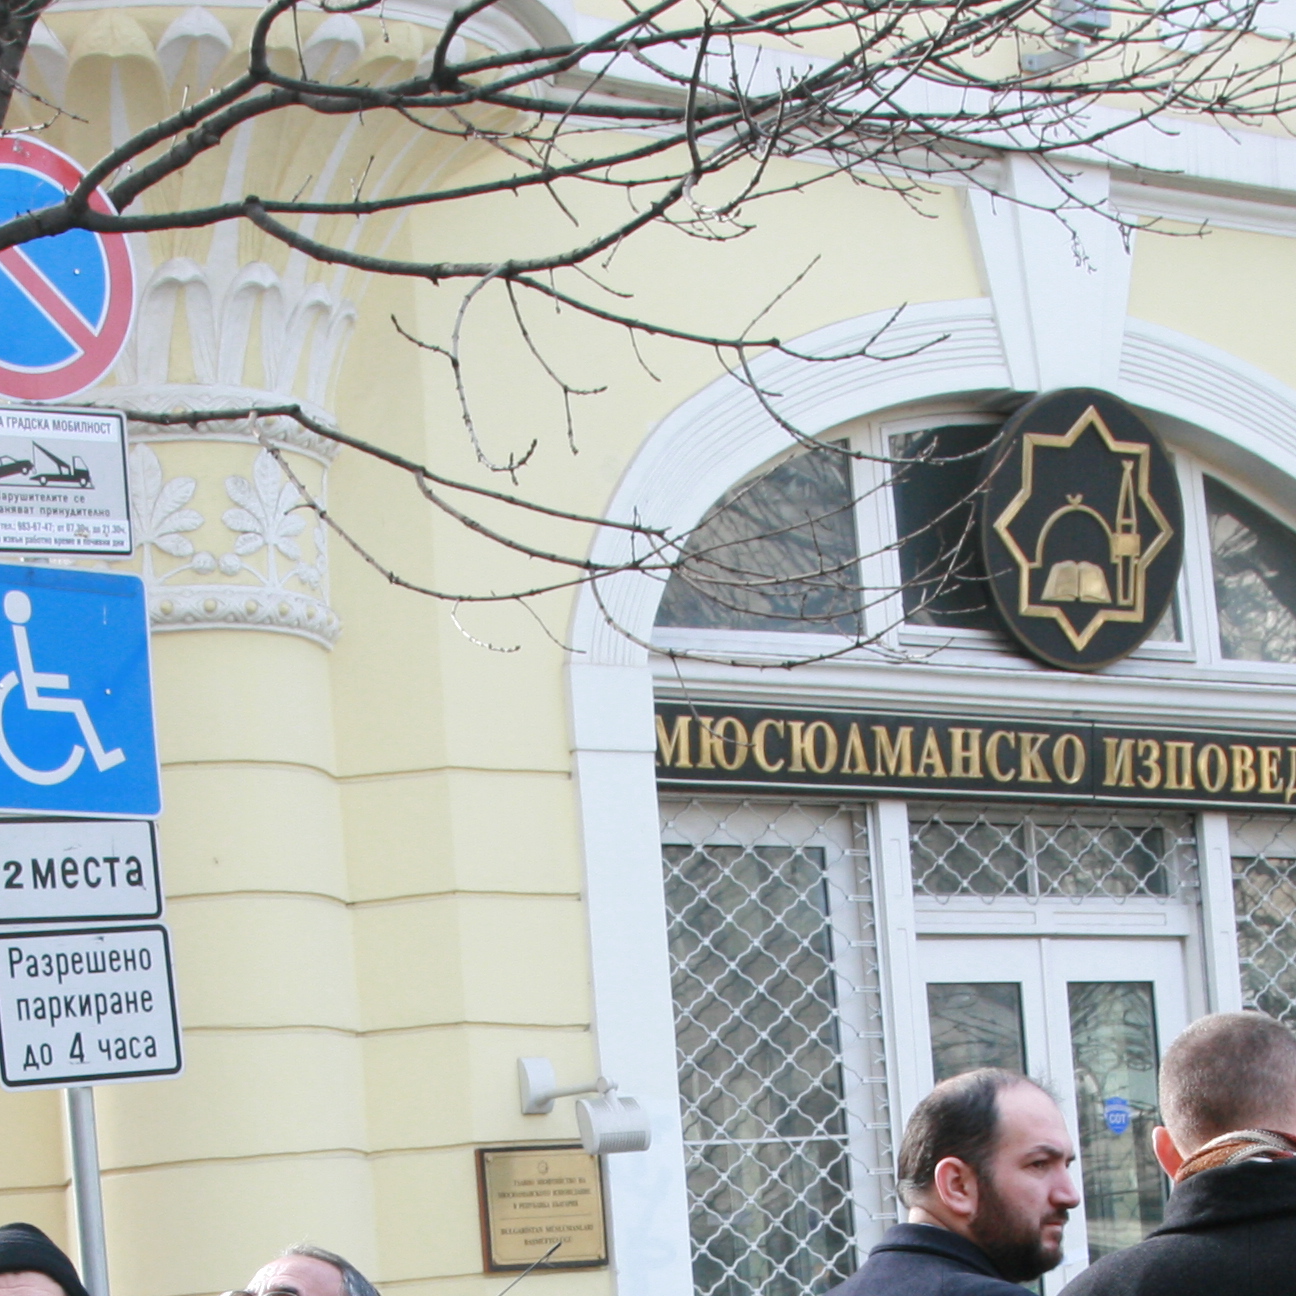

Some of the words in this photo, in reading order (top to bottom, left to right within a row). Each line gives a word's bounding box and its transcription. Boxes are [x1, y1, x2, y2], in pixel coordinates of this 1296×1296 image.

[6, 417, 50, 431] ГРАДСКА
[52, 419, 112, 435] МОБИЛНОСТ
[40, 507, 110, 518] принудително
[74, 494, 85, 504] се
[655, 714, 1085, 784] МЮСЮЛМАНСКО
[3, 860, 24, 890] 2
[31, 856, 144, 890] места
[8, 947, 153, 985] Разрешено
[16, 989, 154, 1028] паркиране
[23, 1042, 53, 1071] до
[69, 1032, 85, 1063] 4
[98, 1034, 158, 1061] часа
